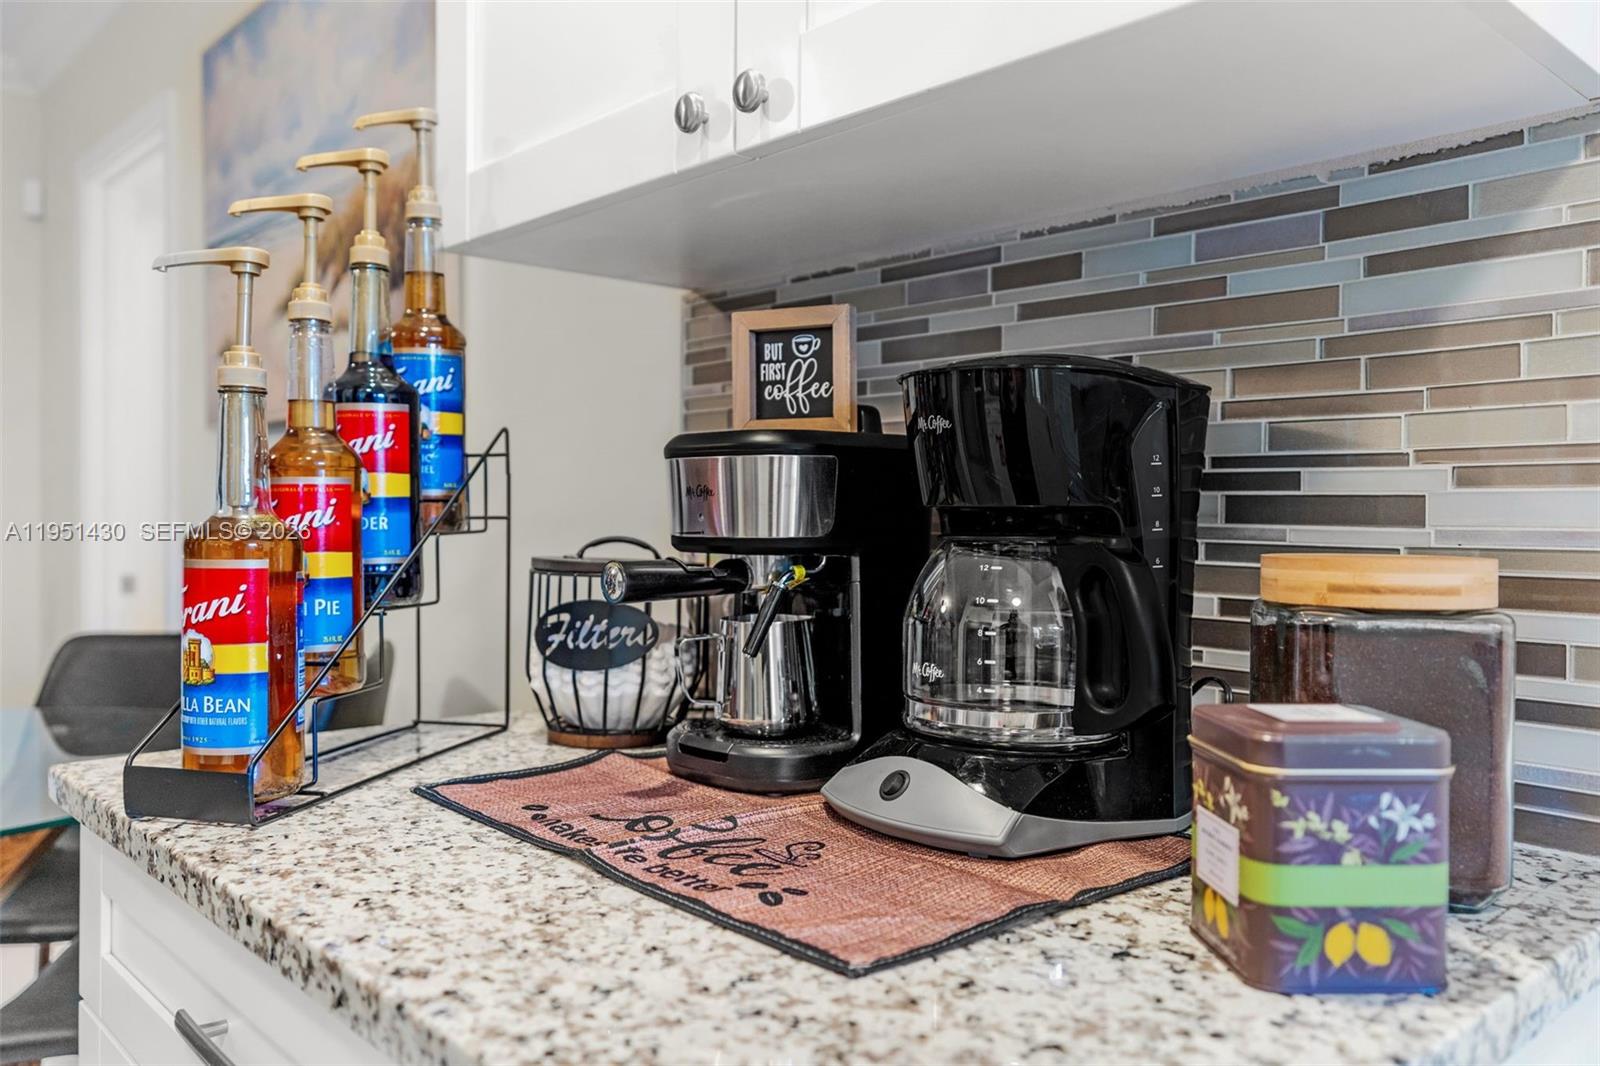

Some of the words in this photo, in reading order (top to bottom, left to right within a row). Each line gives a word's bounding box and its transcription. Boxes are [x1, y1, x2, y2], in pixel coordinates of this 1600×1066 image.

[764, 343, 783, 360] BUT
[760, 363, 786, 381] FIRST
[764, 358, 834, 414] coffee
[928, 415, 952, 435] Coffee
[314, 599, 341, 616] PIE
[544, 612, 655, 657] Filters
[977, 628, 983, 637] 8
[976, 657, 983, 666] 6
[922, 662, 944, 682] Coffee
[976, 686, 983, 694] 4
[203, 695, 251, 714] BEAN
[642, 863, 732, 893] better
